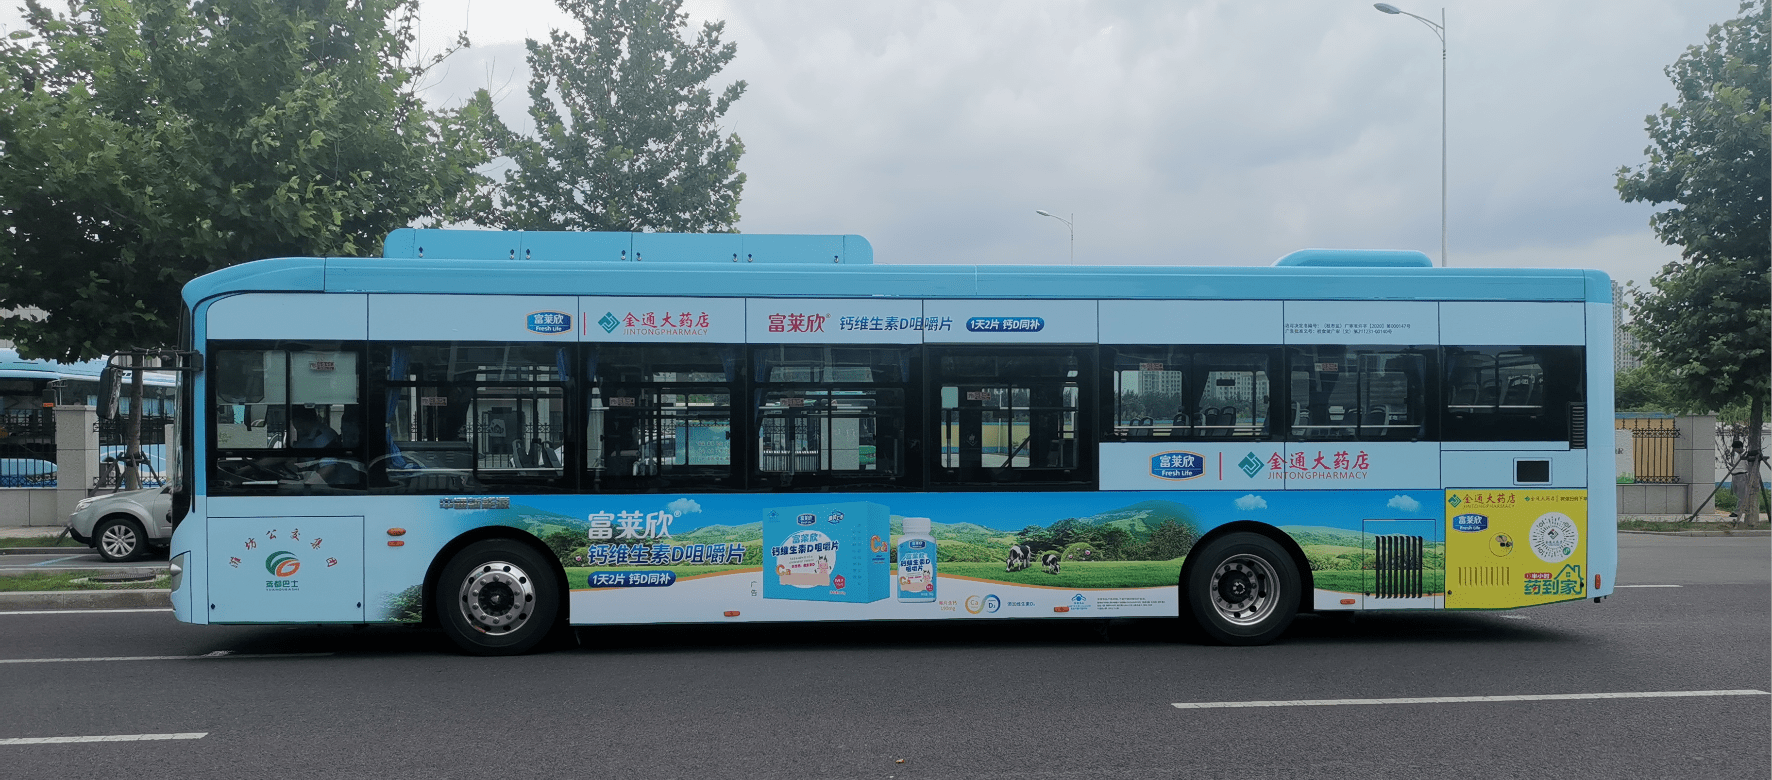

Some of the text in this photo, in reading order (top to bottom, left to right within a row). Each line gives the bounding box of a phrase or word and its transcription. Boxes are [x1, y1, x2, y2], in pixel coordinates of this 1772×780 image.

[534, 313, 564, 325] 富莱欣
[622, 311, 710, 328] 金通大药店
[839, 315, 953, 331] 钙维生素D咀嚼片
[970, 319, 1041, 330] 1天2片 钙D同补
[623, 328, 708, 336] JINTONGPHARMACY
[1159, 455, 1195, 468] 富莱欣
[1267, 450, 1370, 471] 金通大药店
[1161, 469, 1193, 477] Fresh Life
[1268, 471, 1368, 480] JINTONGPHARMACY
[1462, 493, 1516, 504] 金通大药店
[1458, 515, 1483, 525] 富莱欣
[771, 540, 839, 557] 钙维生素D咀嚼片
[870, 534, 888, 553] Ca
[587, 543, 746, 566] 钙维生素D咀嚼片
[592, 573, 672, 586] 1天2片 钙D同补
[1523, 579, 1580, 595] 药到家
